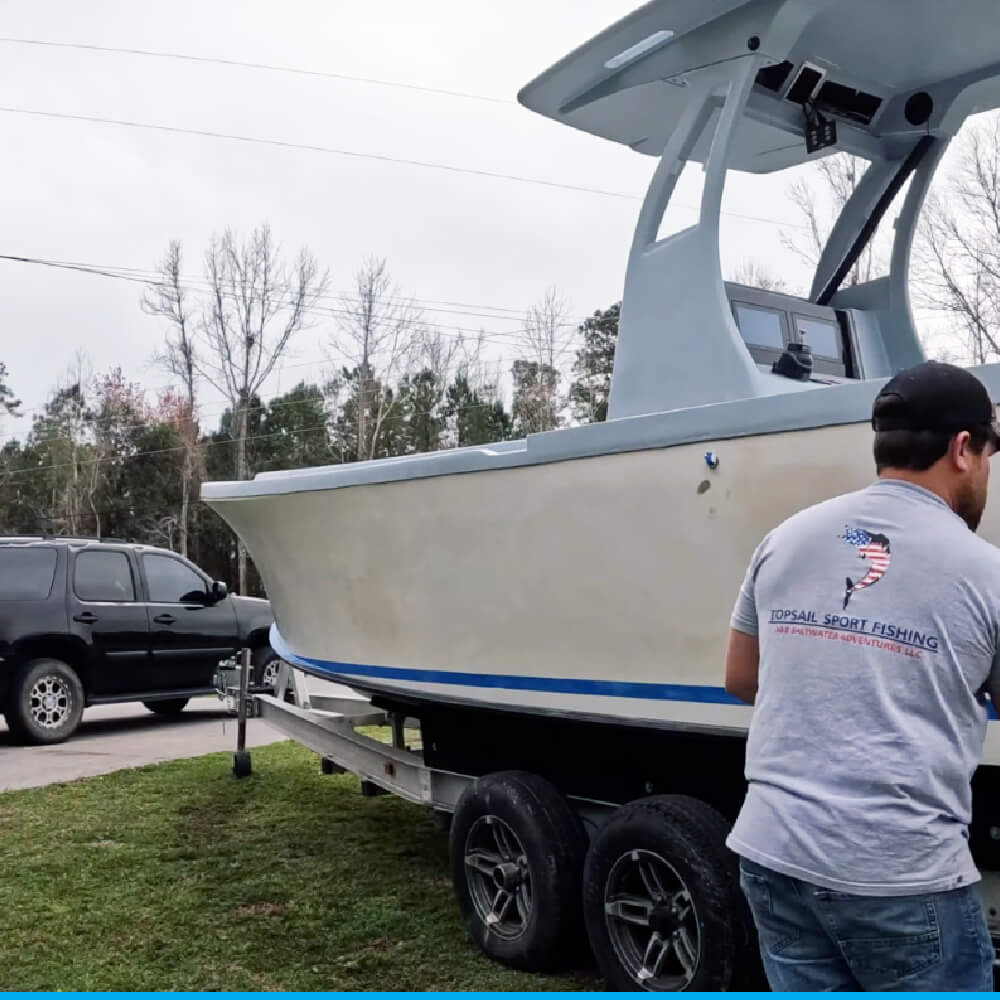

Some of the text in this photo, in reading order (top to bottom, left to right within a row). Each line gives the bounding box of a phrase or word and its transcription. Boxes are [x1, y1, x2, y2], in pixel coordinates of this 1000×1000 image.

[771, 609, 938, 649] TOPSAIL SPORT FISHING
